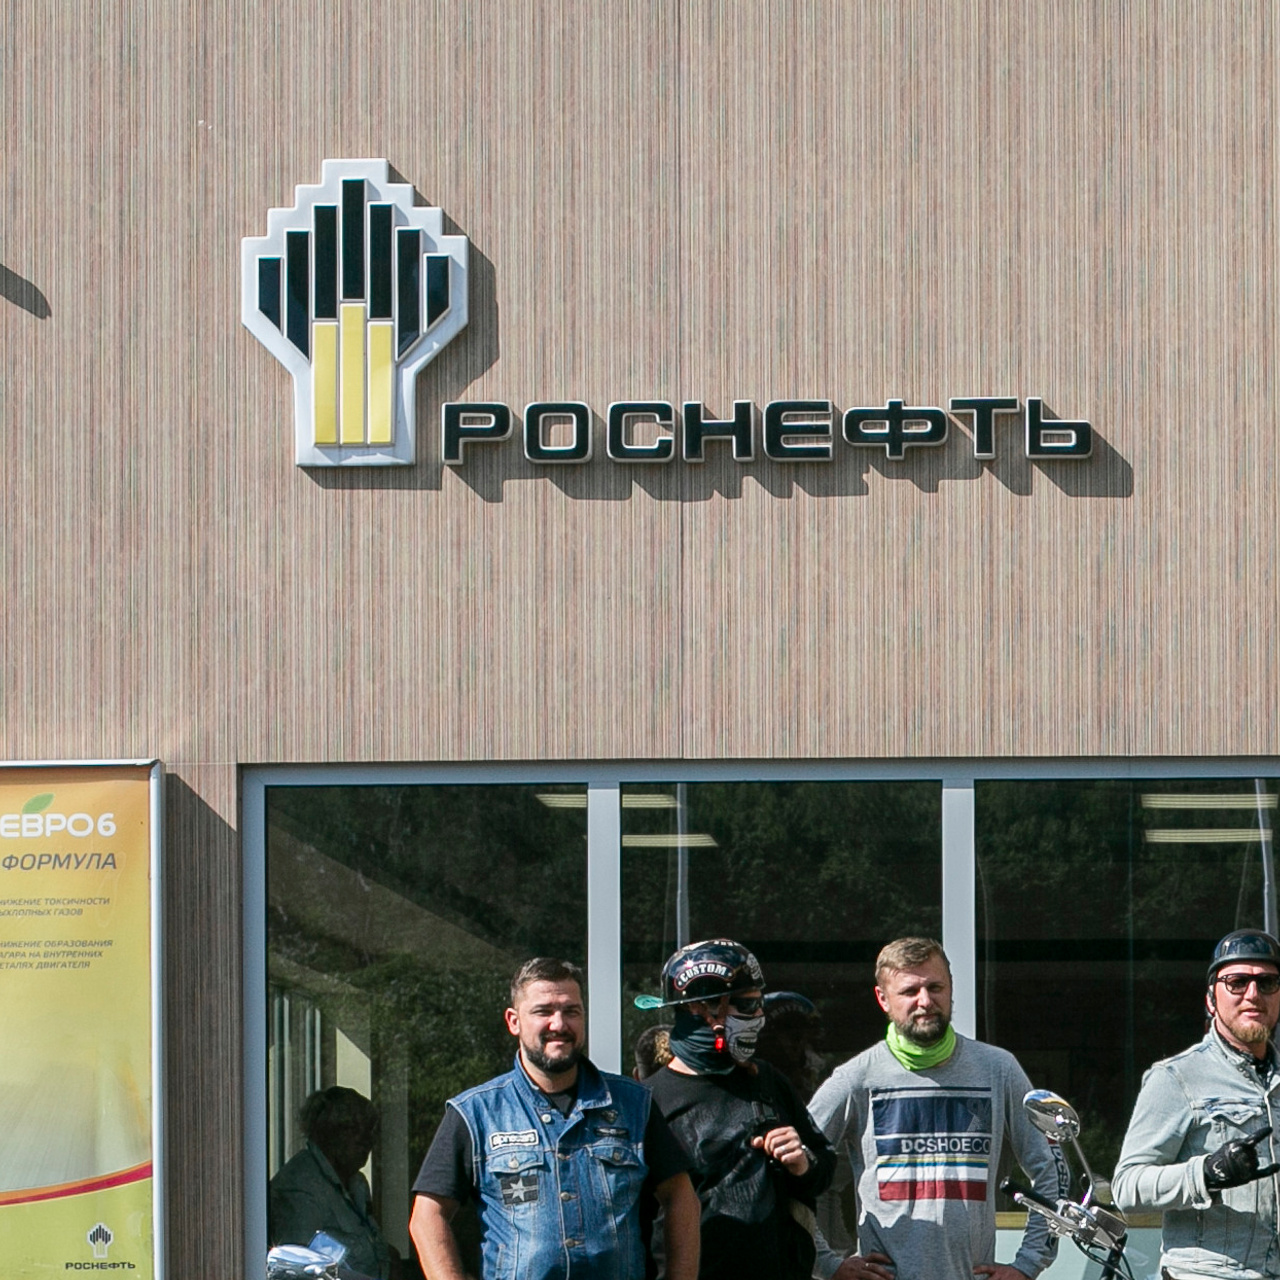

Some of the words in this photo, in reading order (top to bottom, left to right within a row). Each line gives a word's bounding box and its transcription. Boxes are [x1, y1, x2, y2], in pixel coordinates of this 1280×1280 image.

[442, 397, 1093, 465] РОСНЕФТЬ
[2, 853, 117, 870] ФОРМУЛА
[0, 898, 42, 906] ИЖЕНИЕ
[45, 897, 110, 905] ТОКСИЧНОСТИ
[54, 908, 83, 916] ГАЗОВ
[44, 940, 113, 948] ОБРАЗОВАНИЯ
[29, 951, 41, 959] НА
[44, 950, 103, 958] ВНУТРЕННИХ
[36, 961, 90, 970] ДВИГАТЕЛЯ
[680, 963, 727, 983] CUSTOM
[65, 1262, 136, 1270] РОСНЕФТЬ
